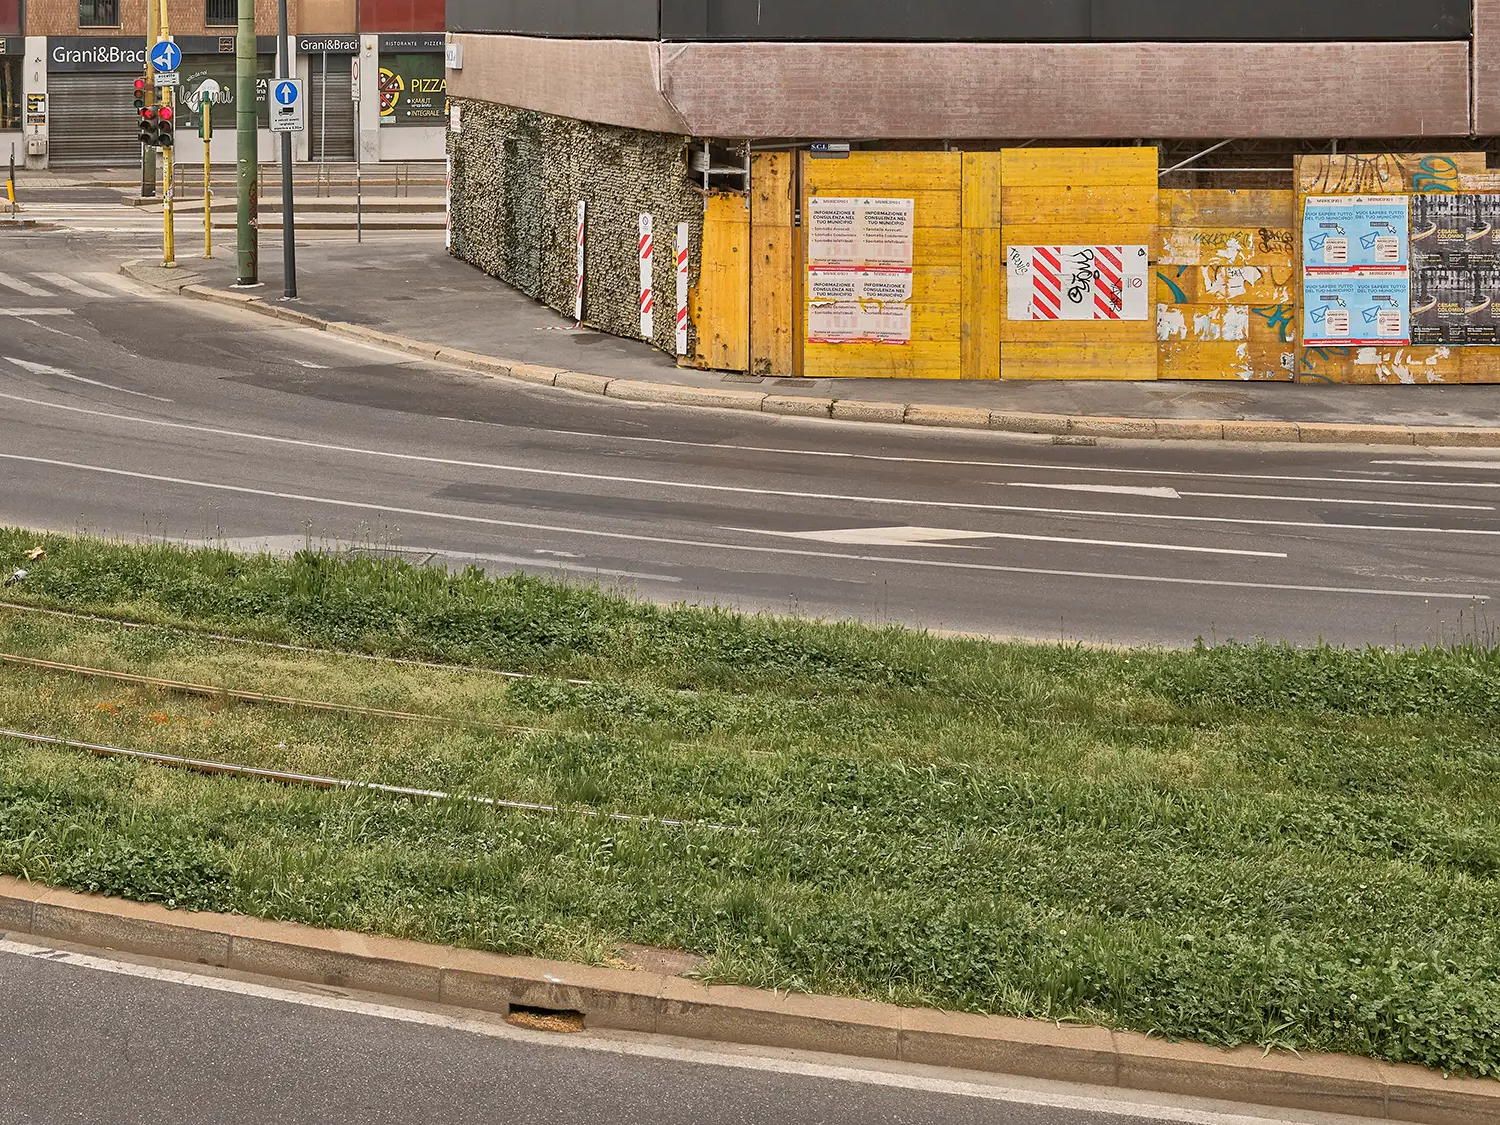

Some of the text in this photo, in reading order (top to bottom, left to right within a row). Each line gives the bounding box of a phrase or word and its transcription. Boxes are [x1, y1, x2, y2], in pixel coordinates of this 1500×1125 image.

[301, 40, 358, 49] Grani&Braci
[52, 46, 148, 63] Grani&Braci
[412, 79, 446, 92] PIZZA
[180, 85, 234, 113] legmi
